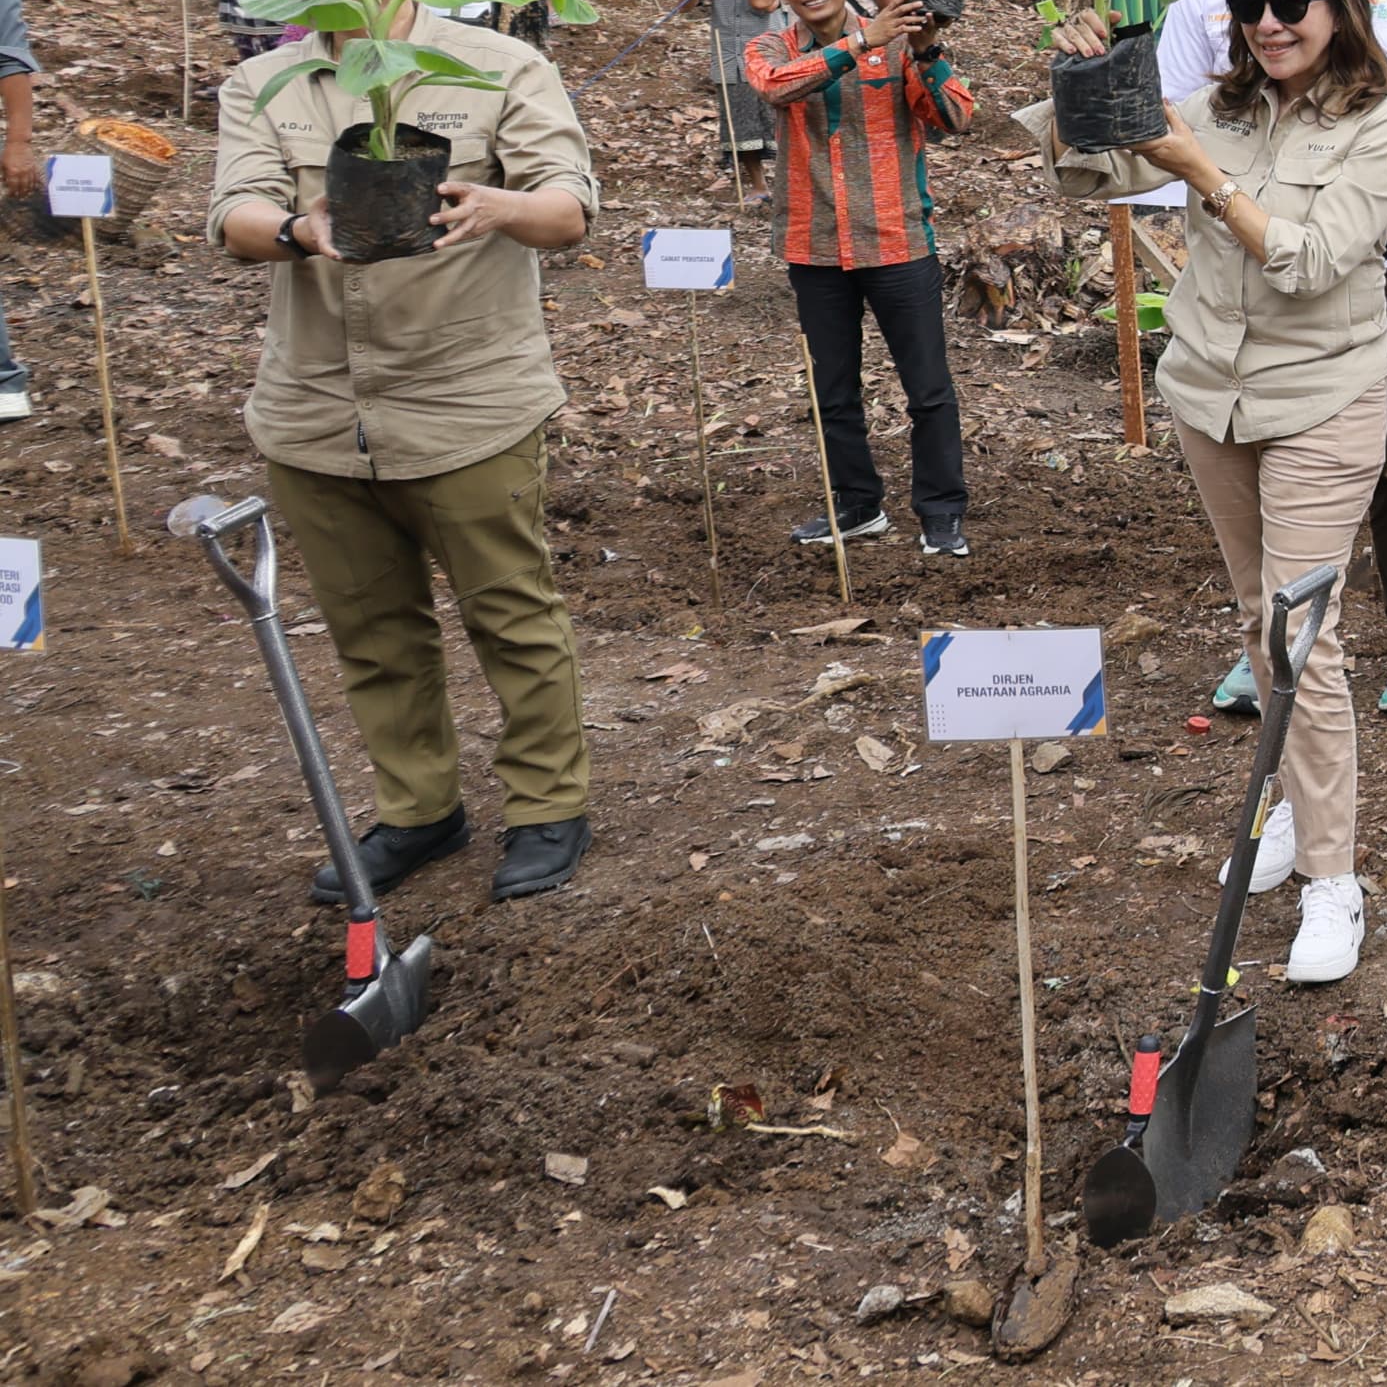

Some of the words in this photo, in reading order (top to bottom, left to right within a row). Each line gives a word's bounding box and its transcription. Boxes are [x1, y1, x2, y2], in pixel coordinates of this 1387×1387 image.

[416, 111, 469, 122] Reforma
[416, 120, 464, 131] Agraria
[0, 569, 20, 581] TERI
[0, 582, 21, 593] RASI
[992, 674, 1034, 685] DIRJEN
[956, 686, 1017, 698] PENATAAN
[1019, 685, 1072, 696] AGRARIA
